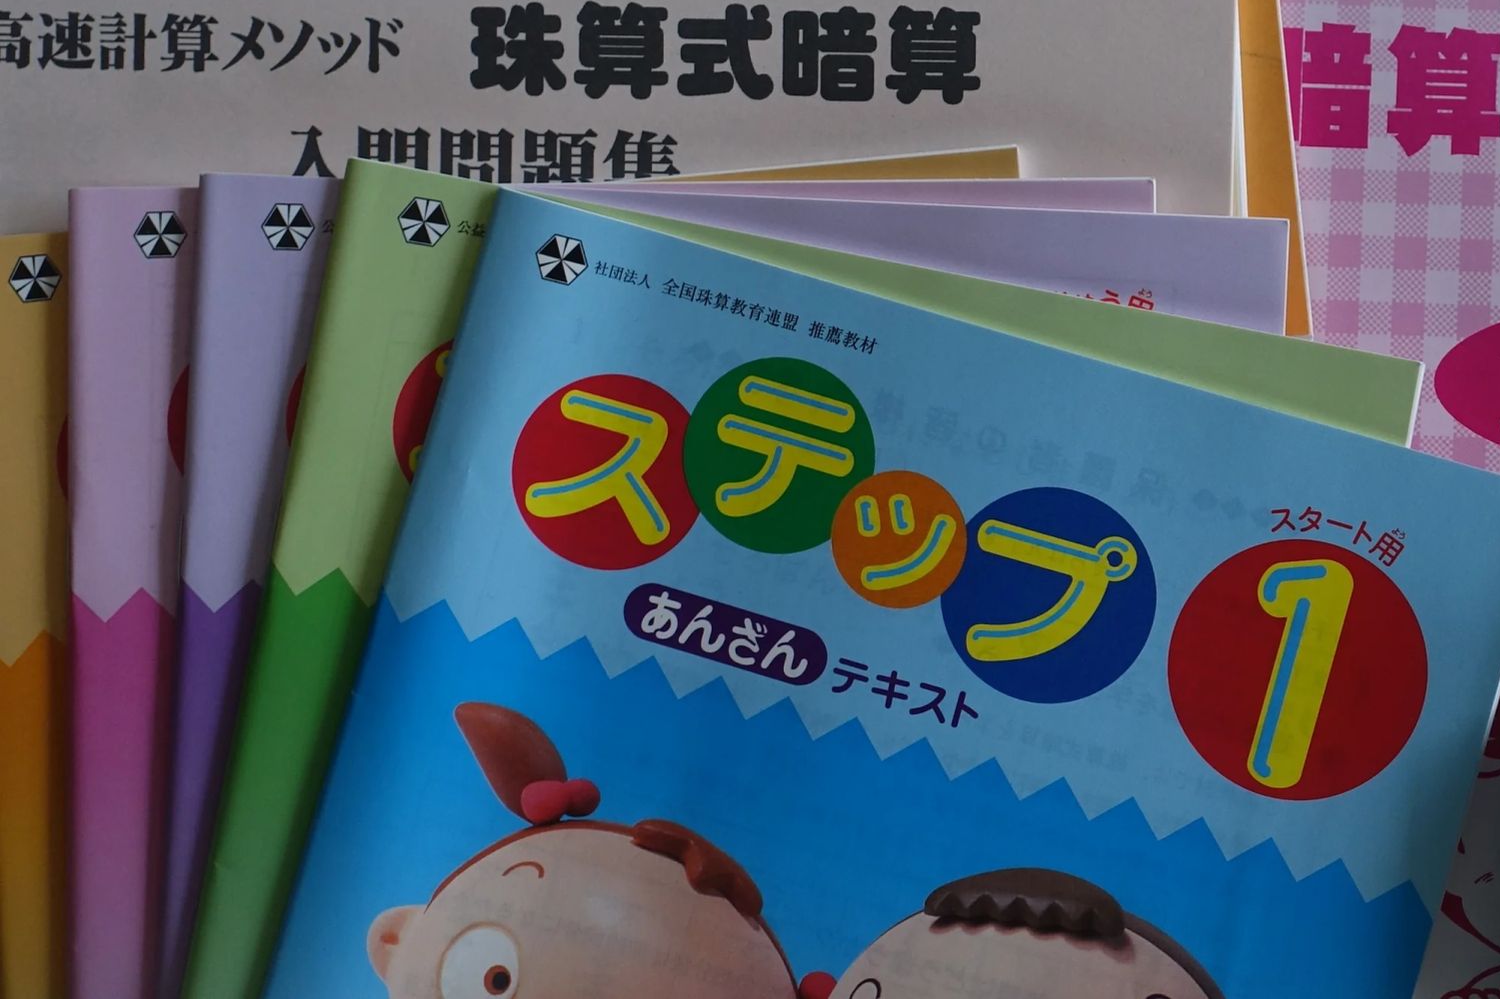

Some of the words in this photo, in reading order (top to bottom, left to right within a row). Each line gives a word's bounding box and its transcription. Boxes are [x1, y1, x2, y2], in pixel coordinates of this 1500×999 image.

[0, 10, 404, 75] 高速計算メソッド
[469, 2, 981, 107] 珠算式暗算
[594, 259, 652, 290] 社団法人
[660, 277, 801, 333] 全国珠算教育連盟
[808, 320, 879, 355] 推薦教材
[525, 375, 1137, 661] ステップ
[1271, 506, 1405, 567] スタート用
[640, 590, 808, 680] あんざん
[832, 657, 979, 728] テキスト
[1248, 559, 1354, 788] 1
